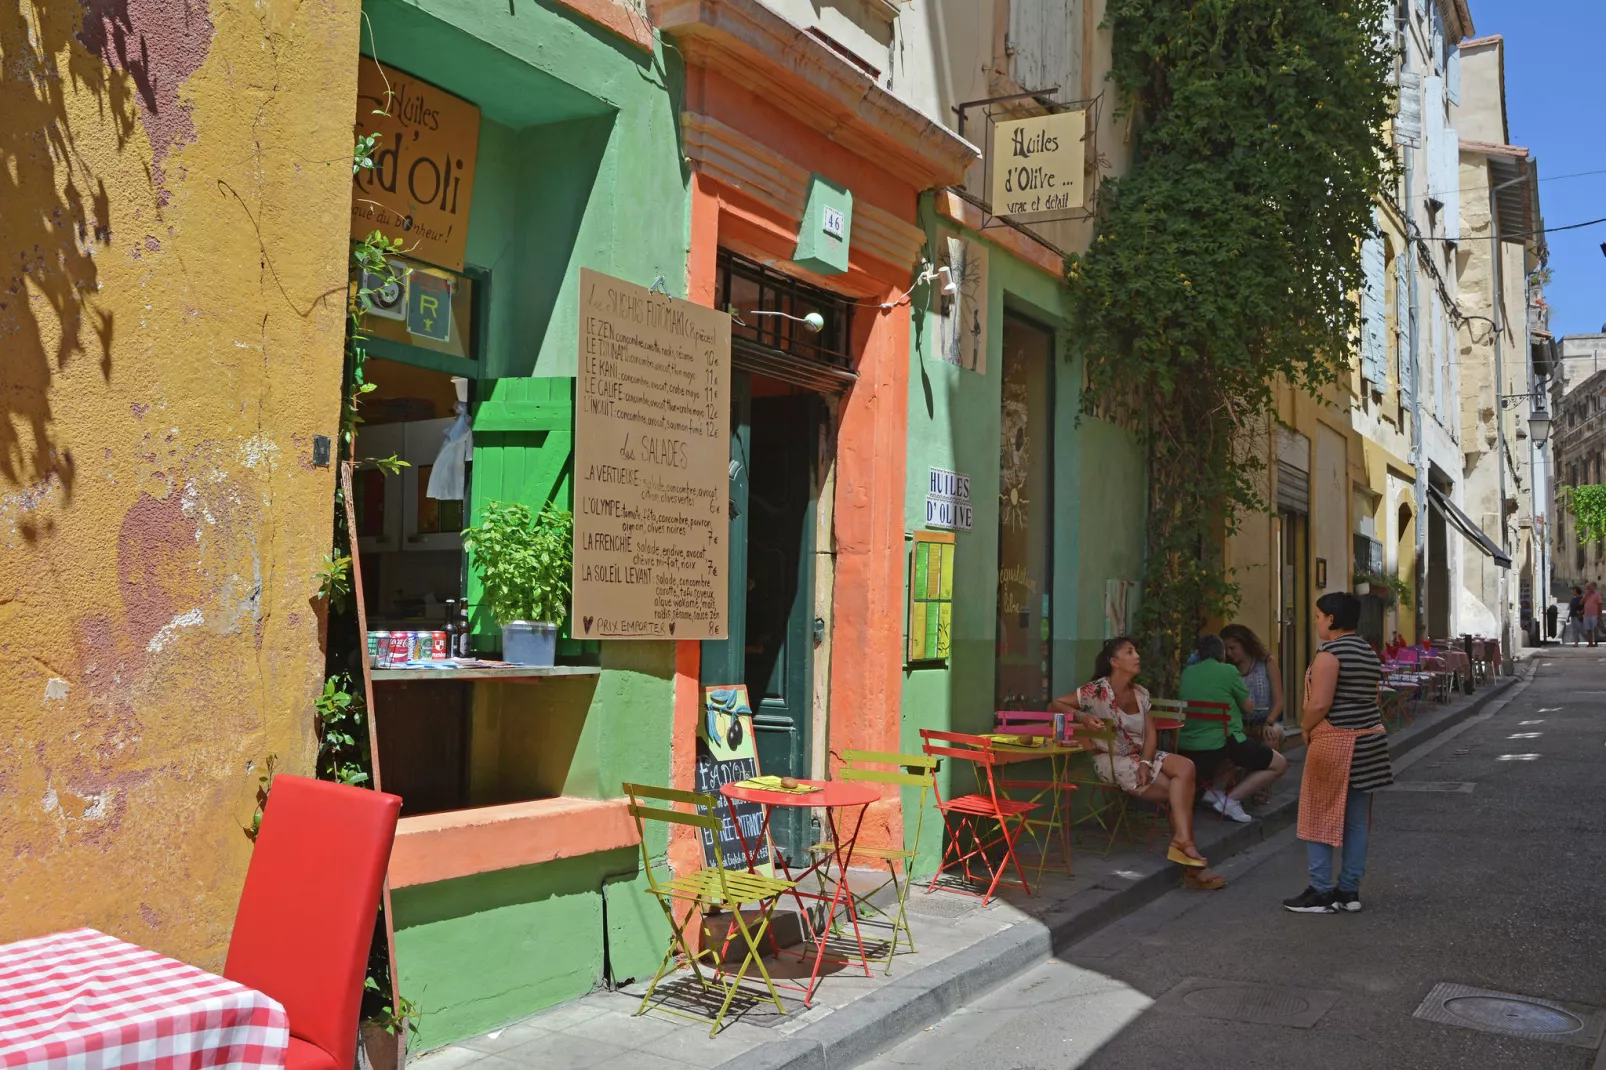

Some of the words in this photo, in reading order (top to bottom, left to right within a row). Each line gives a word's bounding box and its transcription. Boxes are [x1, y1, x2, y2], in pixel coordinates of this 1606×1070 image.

[390, 81, 440, 131] Huiles
[1011, 127, 1059, 158] Huiles
[1005, 166, 1055, 192] d'Olive
[1007, 202, 1027, 213] vrac
[1031, 195, 1040, 211] et
[376, 211, 390, 226] du
[828, 214, 840, 231] 46
[586, 316, 595, 335] LE
[598, 320, 615, 340] ZEN
[586, 336, 596, 354] LE
[586, 356, 596, 374] LE
[704, 386, 718, 402] 11€
[585, 375, 596, 394] LE
[705, 403, 718, 420] 12€
[705, 421, 719, 439] 12€
[619, 432, 635, 461] des
[641, 435, 688, 470] SALADES
[930, 471, 969, 499] HUILES
[709, 498, 720, 514] 6€
[926, 501, 972, 527] D'OLIVE
[583, 532, 593, 550] LA
[707, 530, 719, 547] 7€
[582, 564, 592, 581] LA
[681, 561, 696, 570] noix
[707, 559, 718, 577] 7€
[597, 617, 618, 633] PRIX
[620, 620, 666, 634] EMPORTER
[708, 620, 720, 636] 8€
